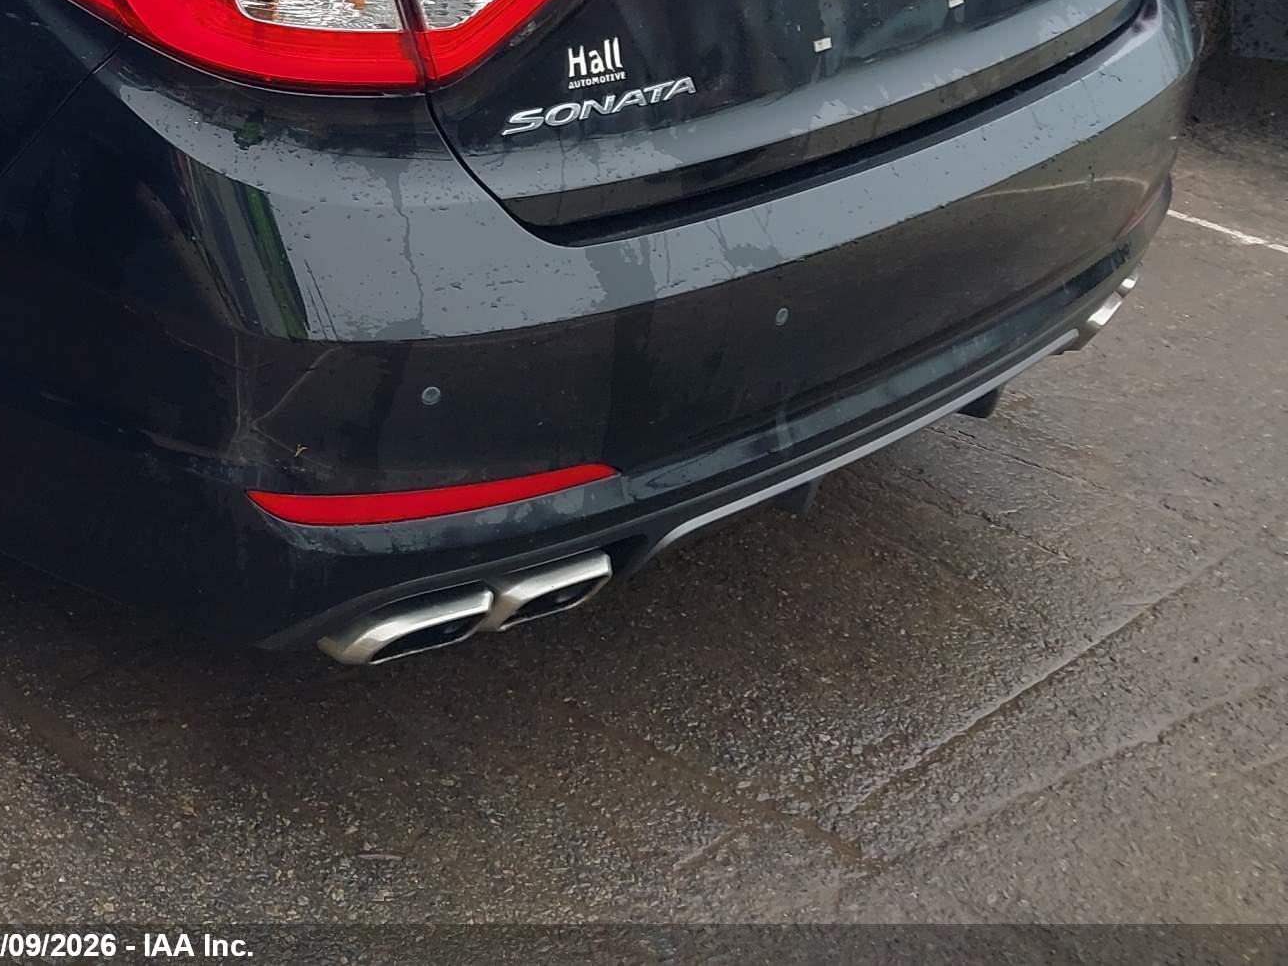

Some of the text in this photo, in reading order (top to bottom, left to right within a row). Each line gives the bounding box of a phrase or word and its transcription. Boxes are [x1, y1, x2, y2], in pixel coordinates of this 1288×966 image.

[567, 36, 623, 78] Hall
[568, 71, 627, 90] AUTOMOTIVE
[502, 76, 696, 136] SONATA
